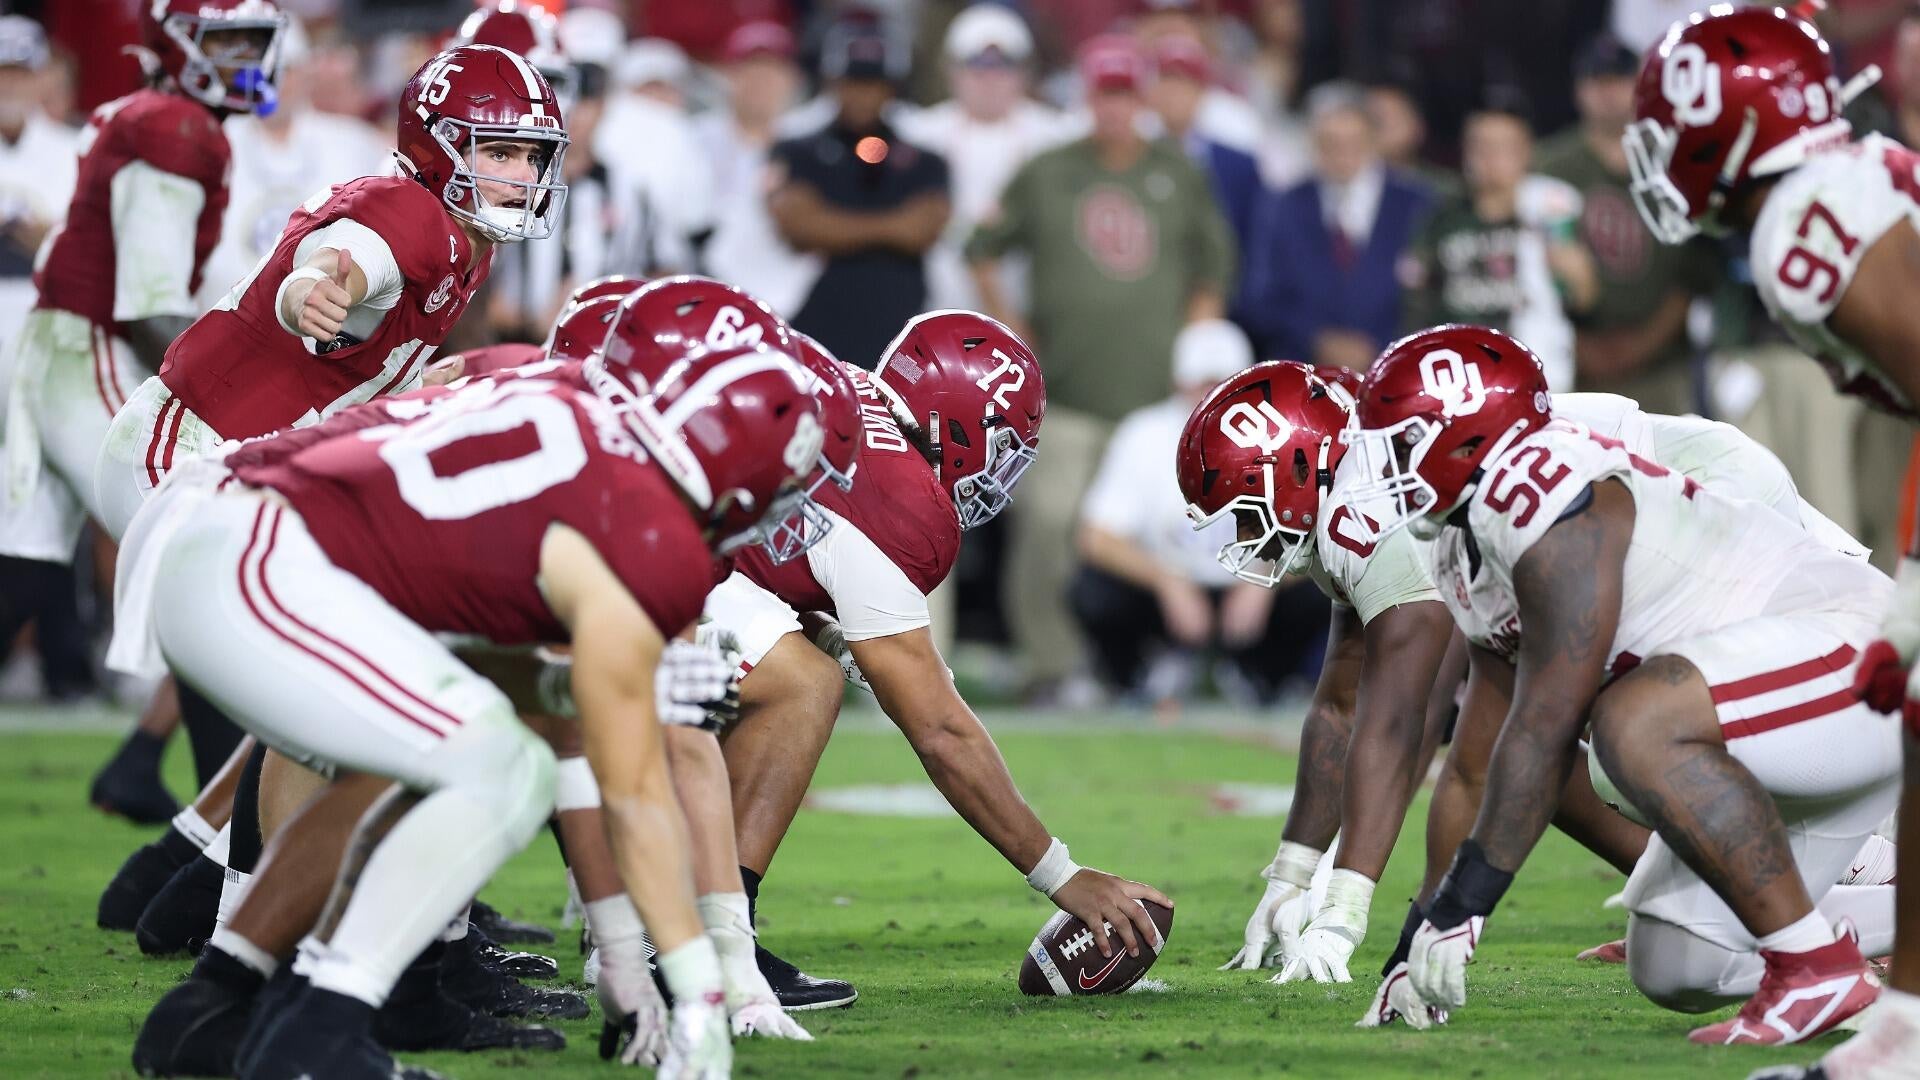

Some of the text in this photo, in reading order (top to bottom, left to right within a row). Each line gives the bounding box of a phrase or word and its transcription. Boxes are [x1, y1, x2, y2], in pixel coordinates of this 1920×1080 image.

[417, 60, 464, 106] 15
[1661, 42, 1723, 127] OU
[533, 116, 555, 128] BAMA
[1778, 200, 1860, 304] 97
[976, 348, 1026, 411] 72
[1419, 348, 1486, 417] OU
[1220, 400, 1291, 451] OU
[1484, 446, 1572, 528] 52
